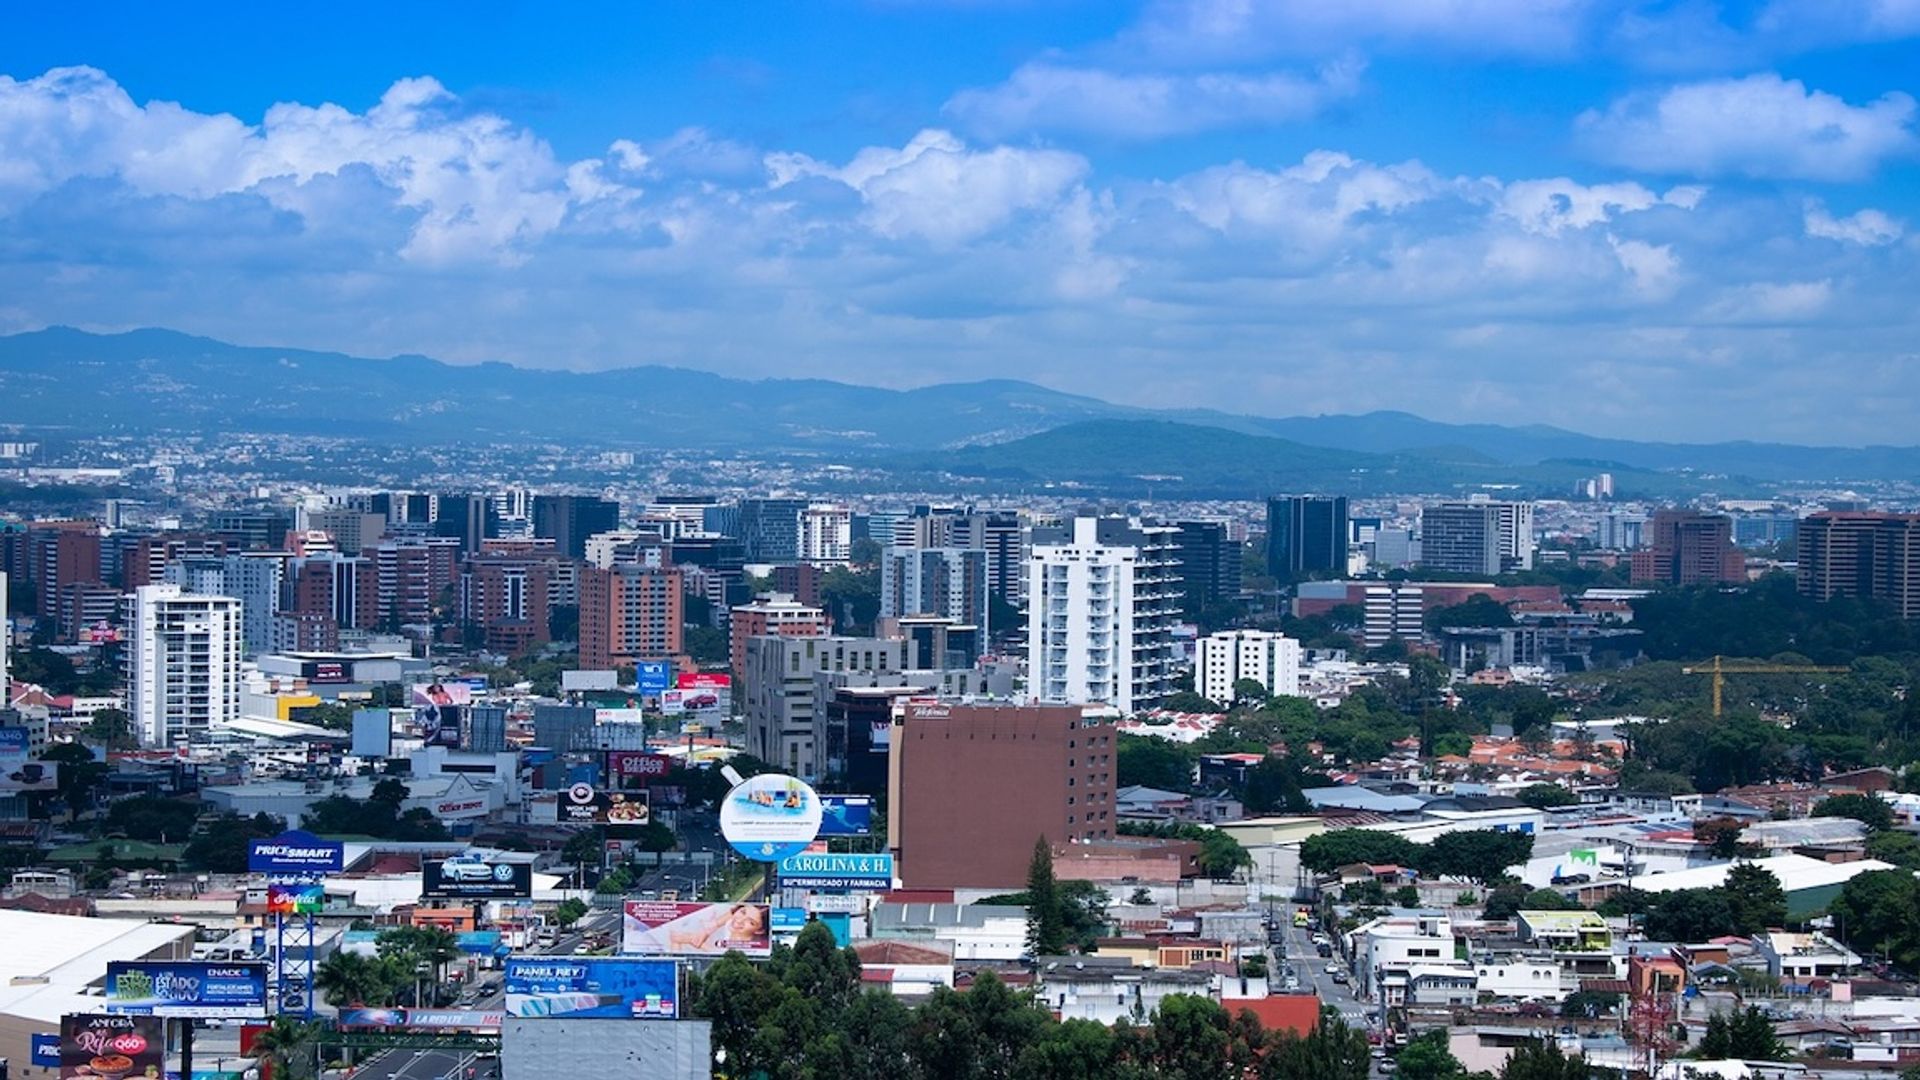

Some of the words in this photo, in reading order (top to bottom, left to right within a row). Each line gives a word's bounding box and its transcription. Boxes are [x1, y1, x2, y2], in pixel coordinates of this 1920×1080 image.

[621, 756, 664, 766] Office
[623, 765, 664, 774] DEPOT
[438, 802, 461, 814] Office
[462, 800, 483, 811] DEPOT
[783, 857, 856, 872] CAROLINA
[859, 858, 871, 872] &
[874, 858, 888, 872] H.
[783, 878, 842, 887] SUPERMERCADO
[843, 878, 849, 886] Y
[850, 878, 887, 888] FARMACIA
[516, 966, 552, 977] PANEL
[555, 967, 580, 977] REY
[156, 976, 200, 990] ESTADO
